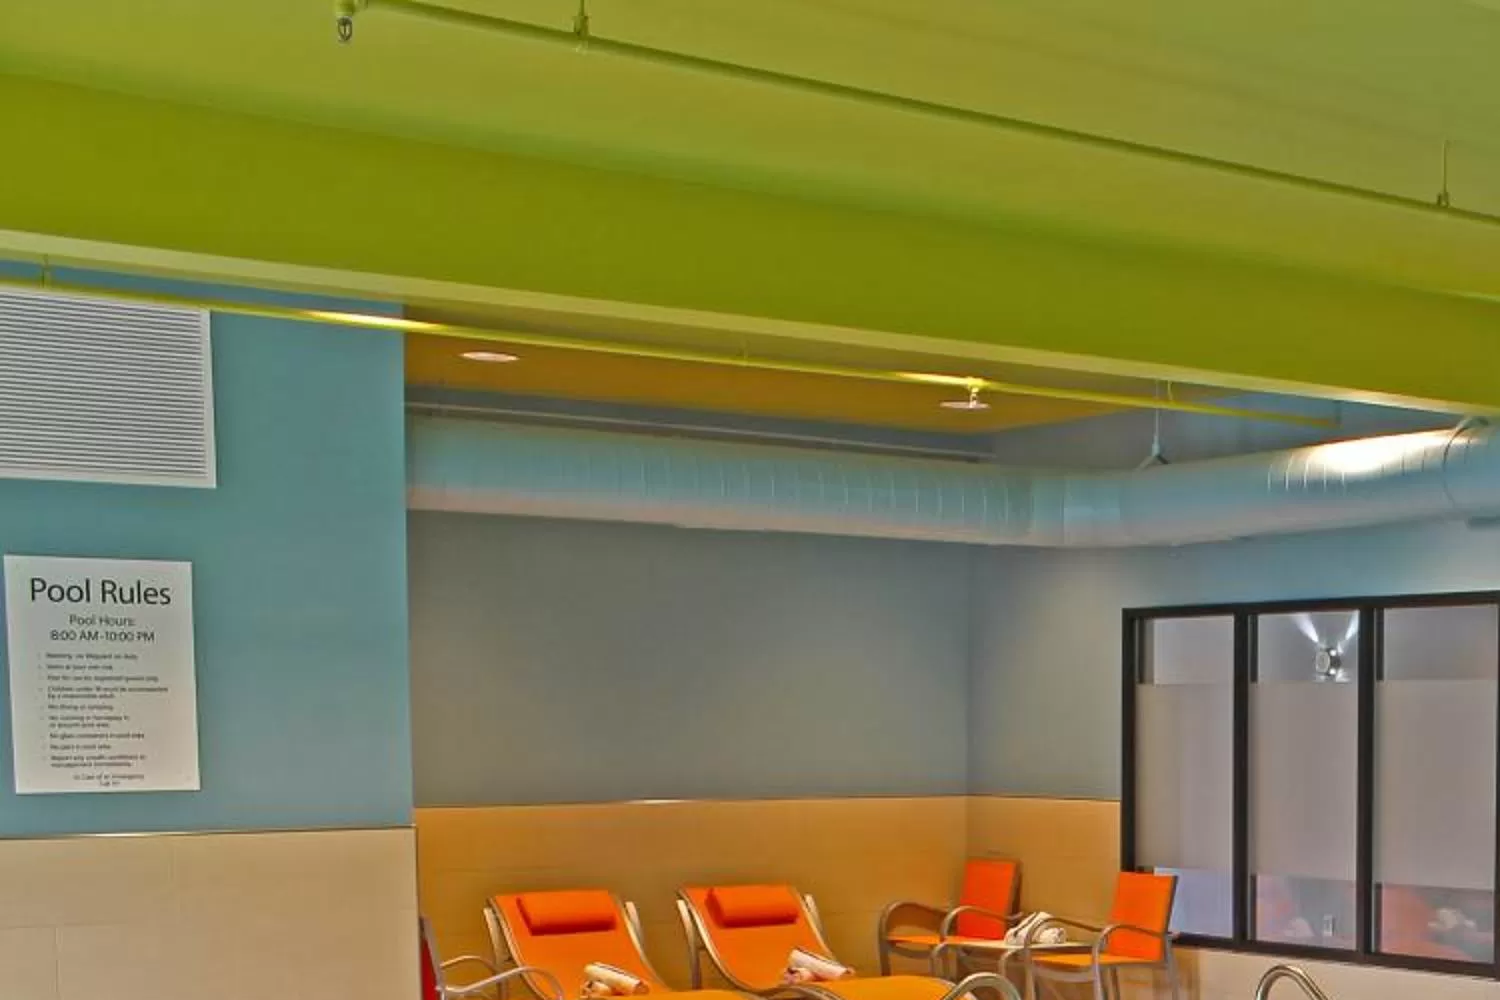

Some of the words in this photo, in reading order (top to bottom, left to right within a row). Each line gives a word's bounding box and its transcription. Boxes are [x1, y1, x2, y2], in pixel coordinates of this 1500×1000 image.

[30, 577, 91, 603] Pool
[101, 579, 172, 605] Rules
[69, 614, 96, 626] Pool
[50, 629, 77, 641] 8:00
[136, 632, 155, 643] PM
